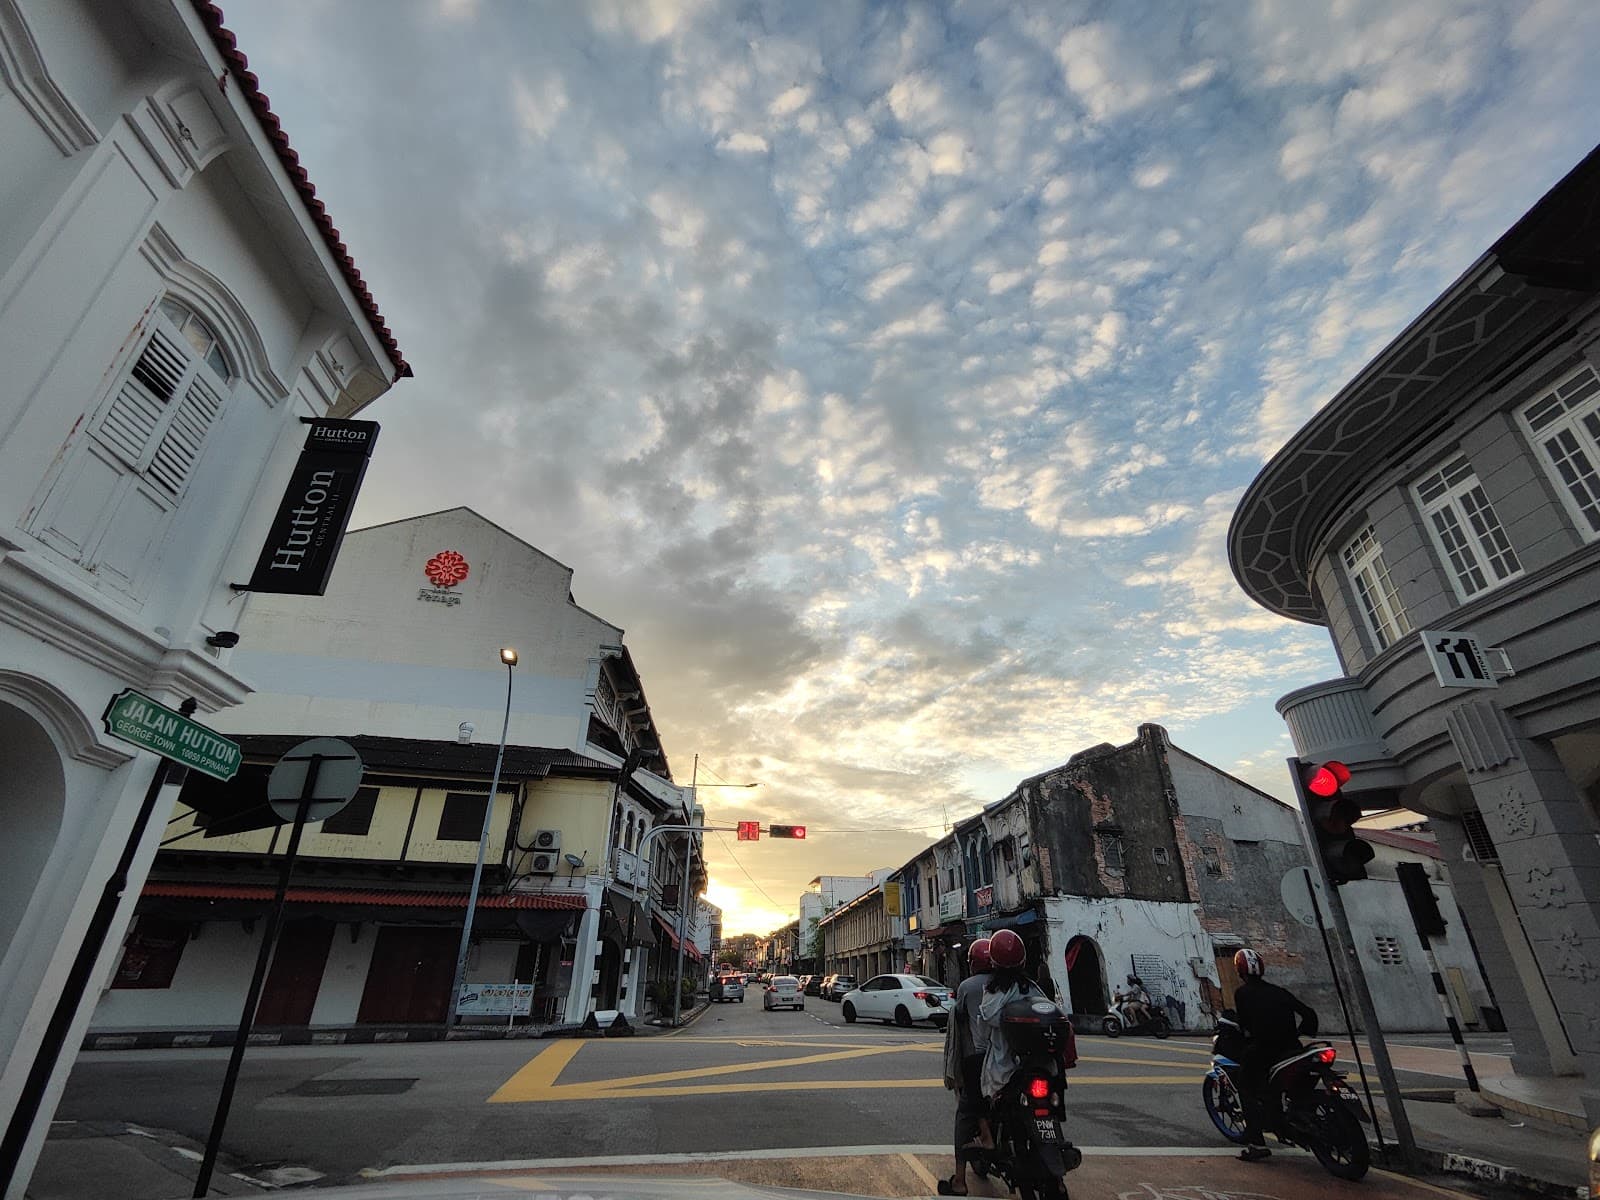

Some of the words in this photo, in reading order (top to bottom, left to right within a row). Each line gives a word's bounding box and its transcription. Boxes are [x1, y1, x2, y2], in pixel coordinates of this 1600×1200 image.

[313, 426, 367, 440] Hutton
[270, 469, 336, 572] Hutton
[315, 504, 336, 547] CENTRAL
[1435, 639, 1485, 679] 11
[1476, 655, 1490, 680] HUTTON
[116, 720, 153, 742] GEORGE
[153, 734, 176, 752] TOWN
[181, 747, 201, 763] 10050
[122, 701, 179, 738] JALAN
[179, 725, 237, 764] HUTTON
